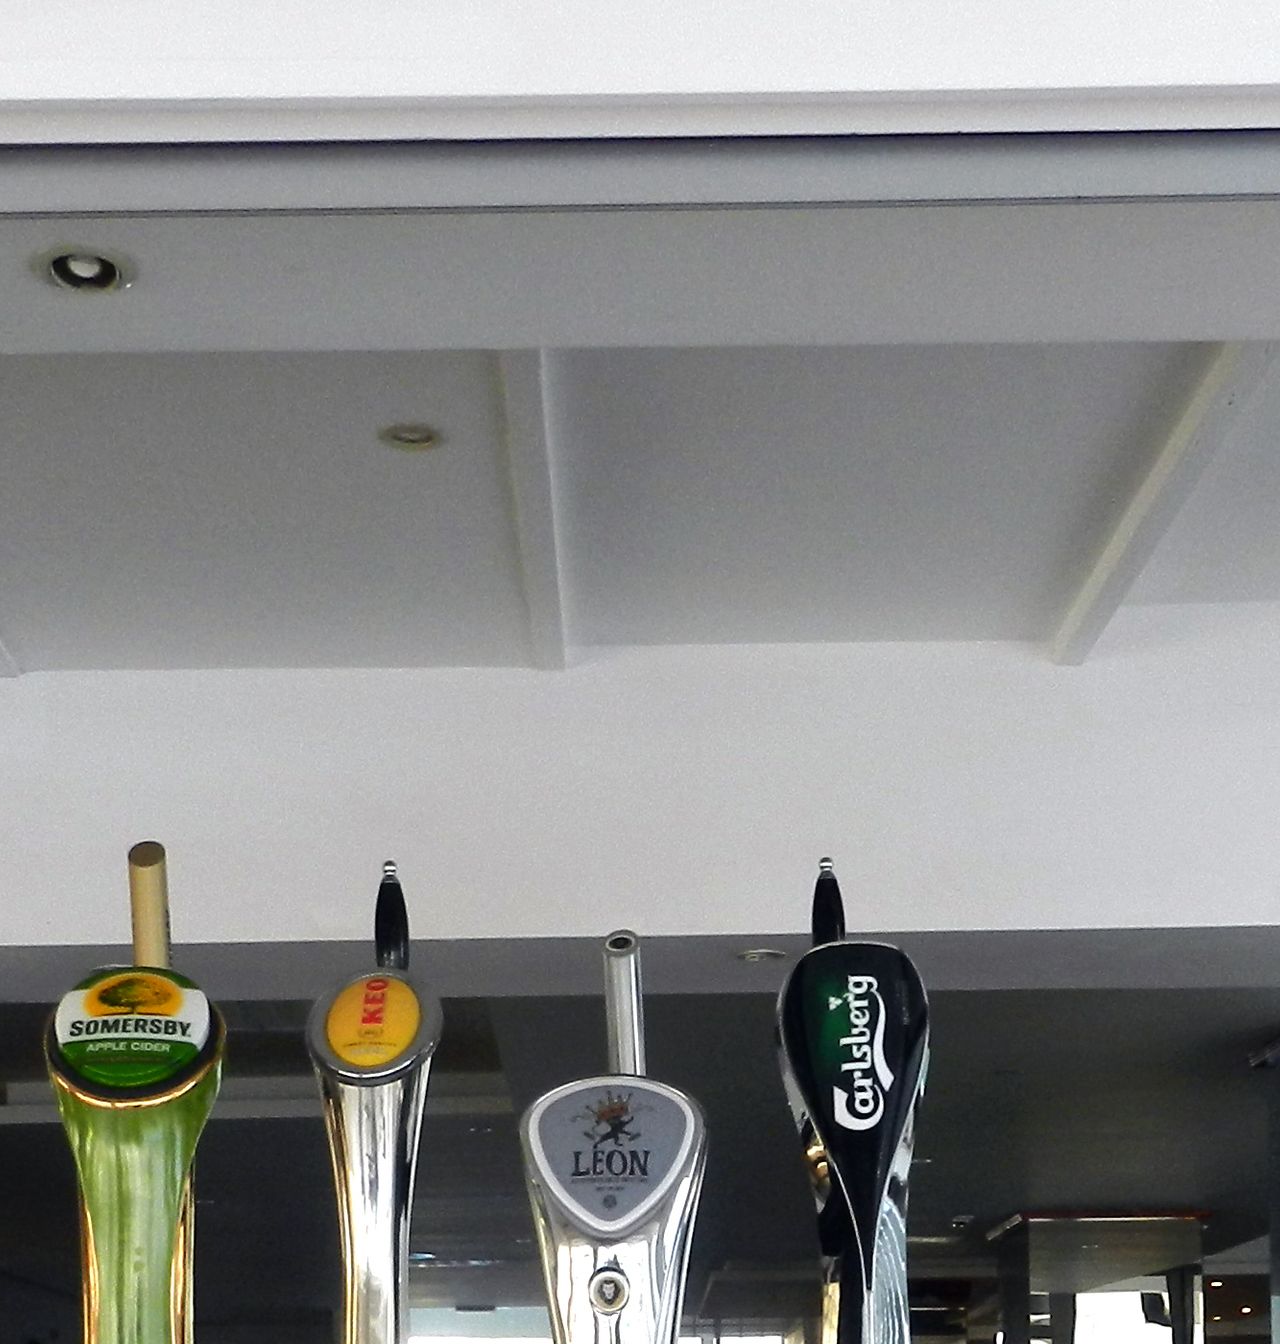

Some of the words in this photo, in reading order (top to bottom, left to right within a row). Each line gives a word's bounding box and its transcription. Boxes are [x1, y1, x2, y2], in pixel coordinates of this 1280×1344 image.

[361, 978, 389, 1024] KEO
[69, 1018, 192, 1037] SOMERSBY
[86, 1041, 127, 1053] APPLE
[130, 1042, 171, 1053] CIDER
[832, 974, 895, 1131] Carlsberg
[571, 1149, 650, 1176] LEON
